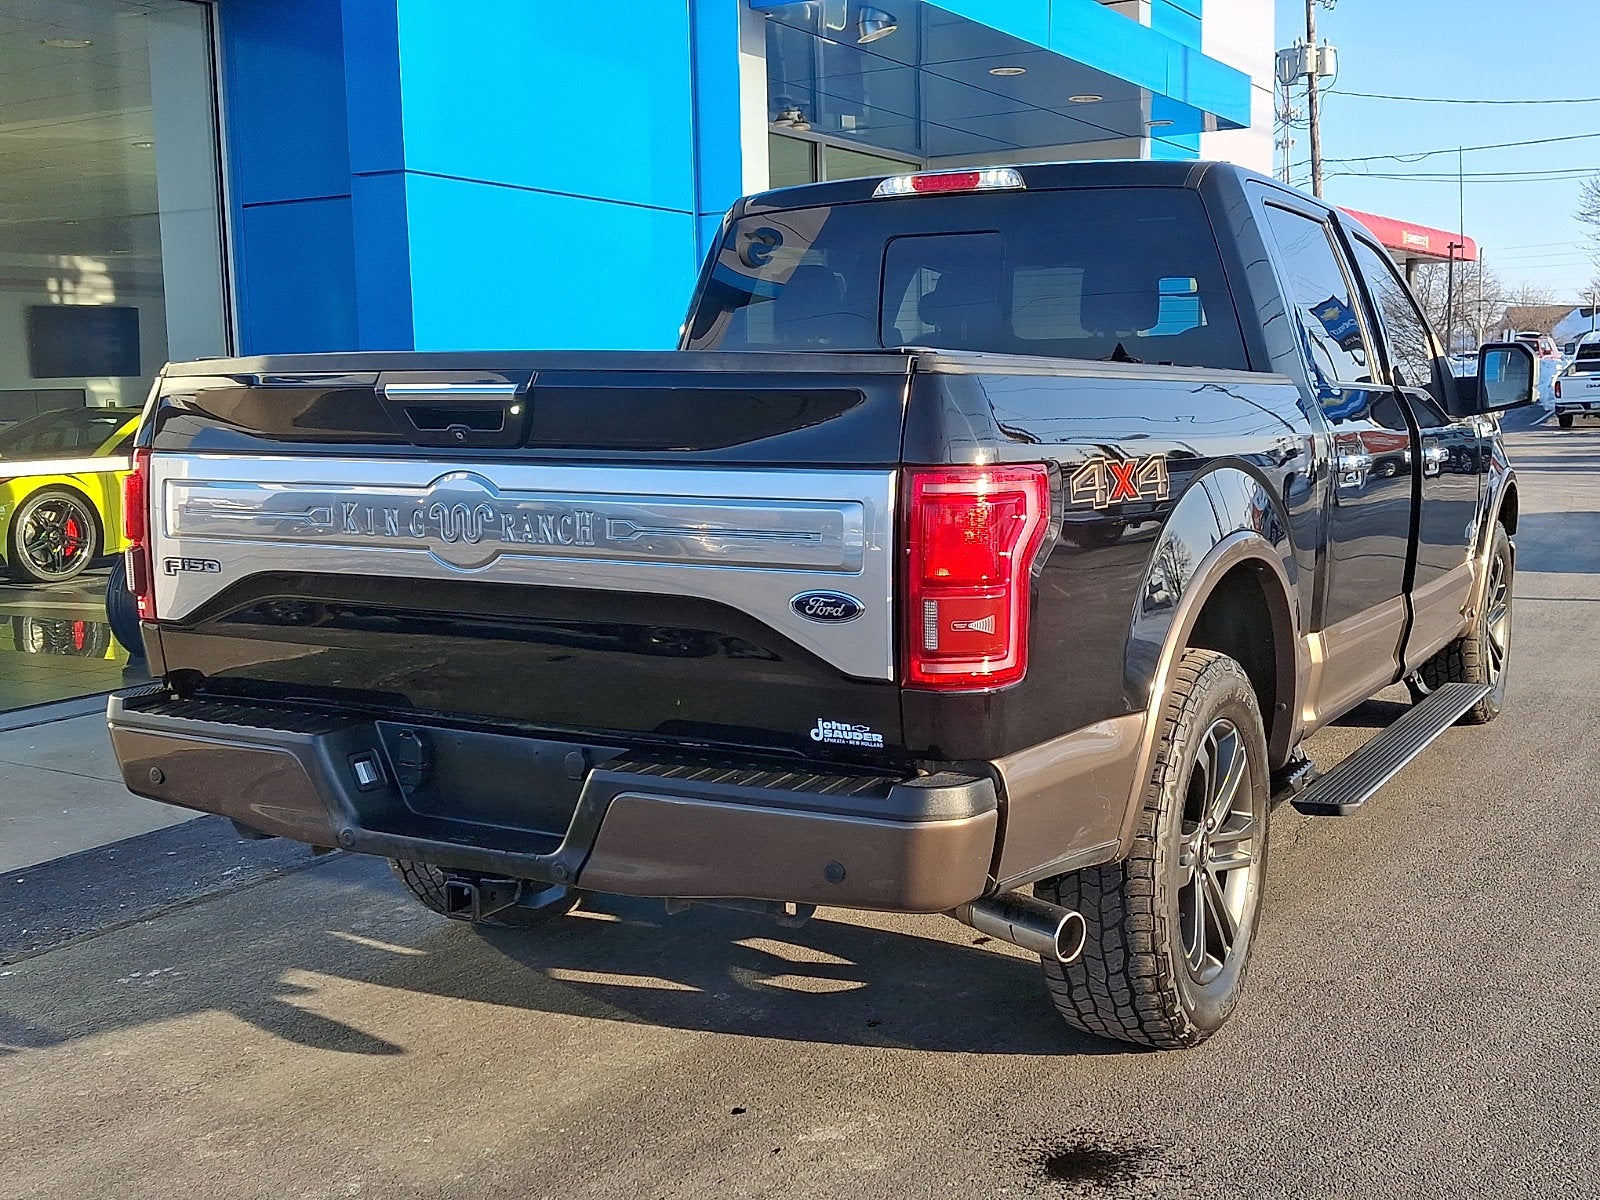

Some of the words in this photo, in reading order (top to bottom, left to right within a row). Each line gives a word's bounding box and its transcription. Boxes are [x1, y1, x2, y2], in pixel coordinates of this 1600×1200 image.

[341, 500, 426, 538] KING
[499, 510, 596, 546] RANCH
[804, 596, 846, 617] Ford
[823, 729, 883, 743] SAUDER
